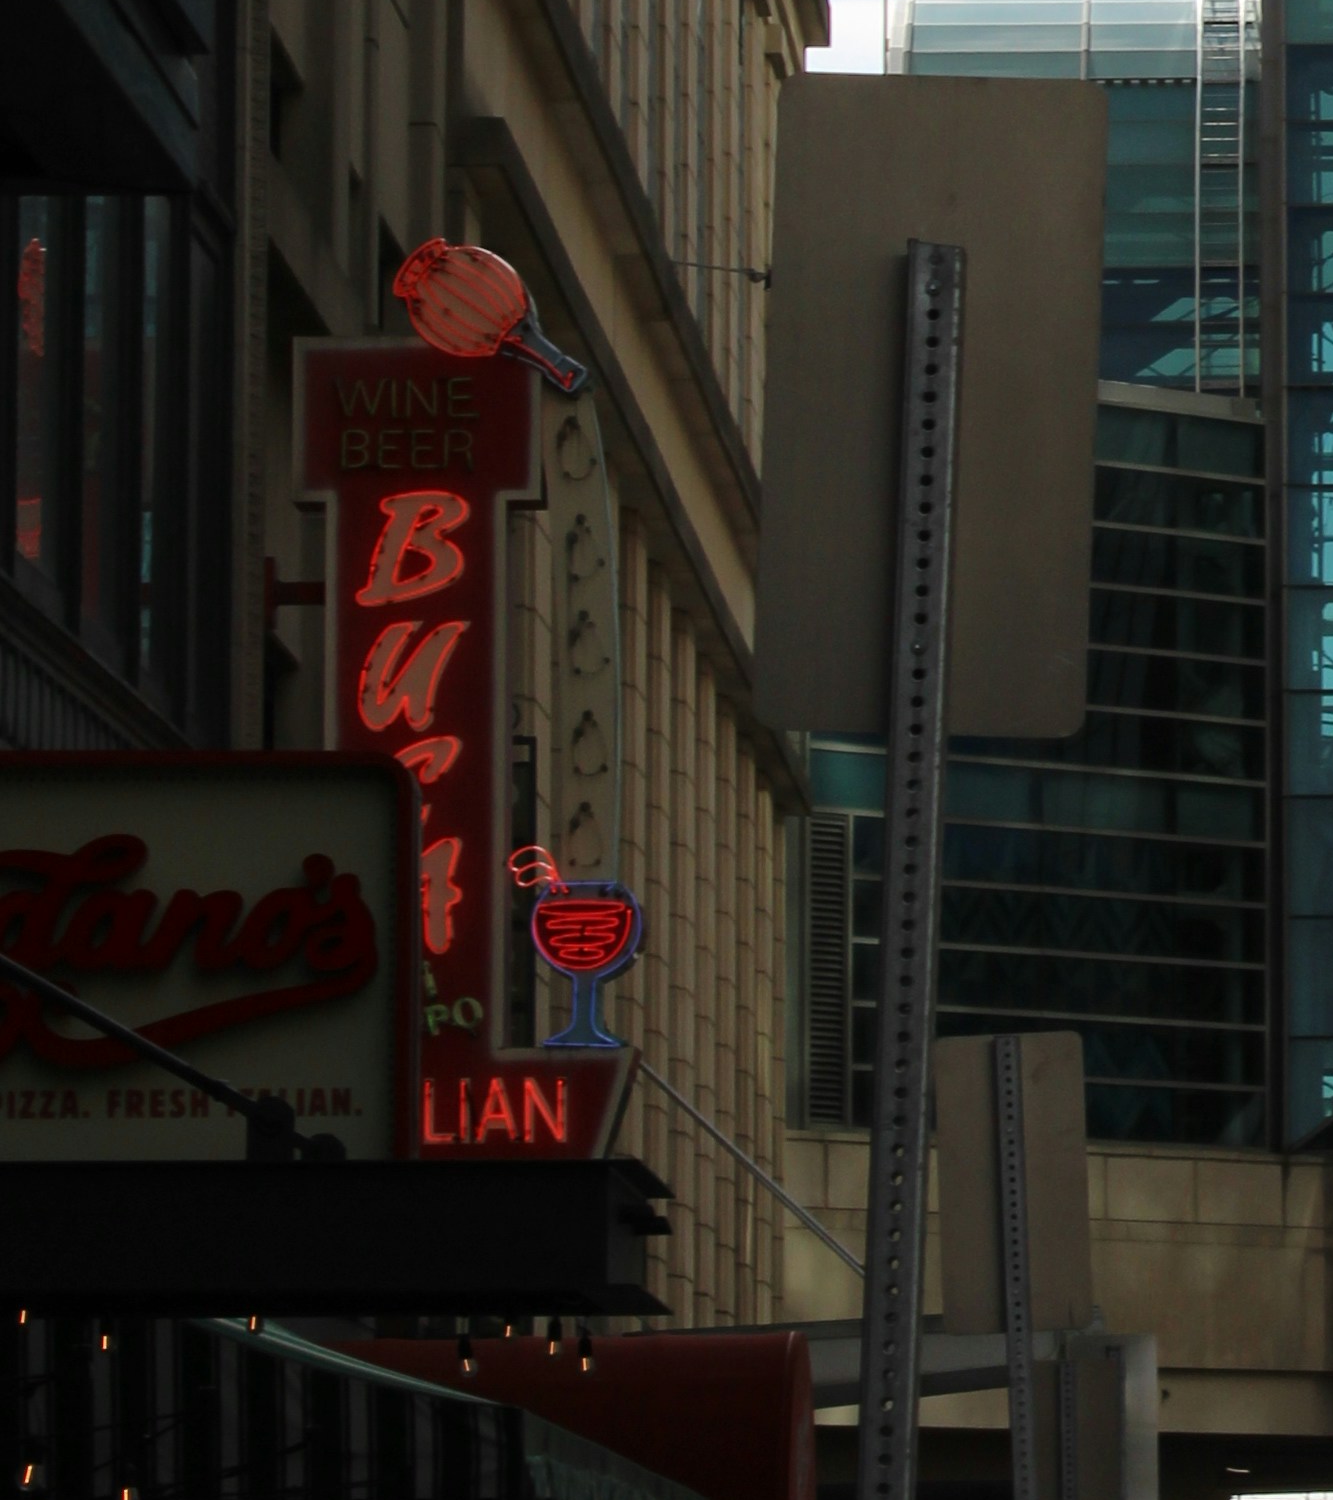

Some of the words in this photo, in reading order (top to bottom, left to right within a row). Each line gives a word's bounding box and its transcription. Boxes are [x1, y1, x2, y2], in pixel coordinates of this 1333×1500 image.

[335, 375, 480, 420] WINE
[340, 429, 475, 471] BEER
[0, 1090, 91, 1119] IZZA.
[106, 1088, 209, 1119] FRESH
